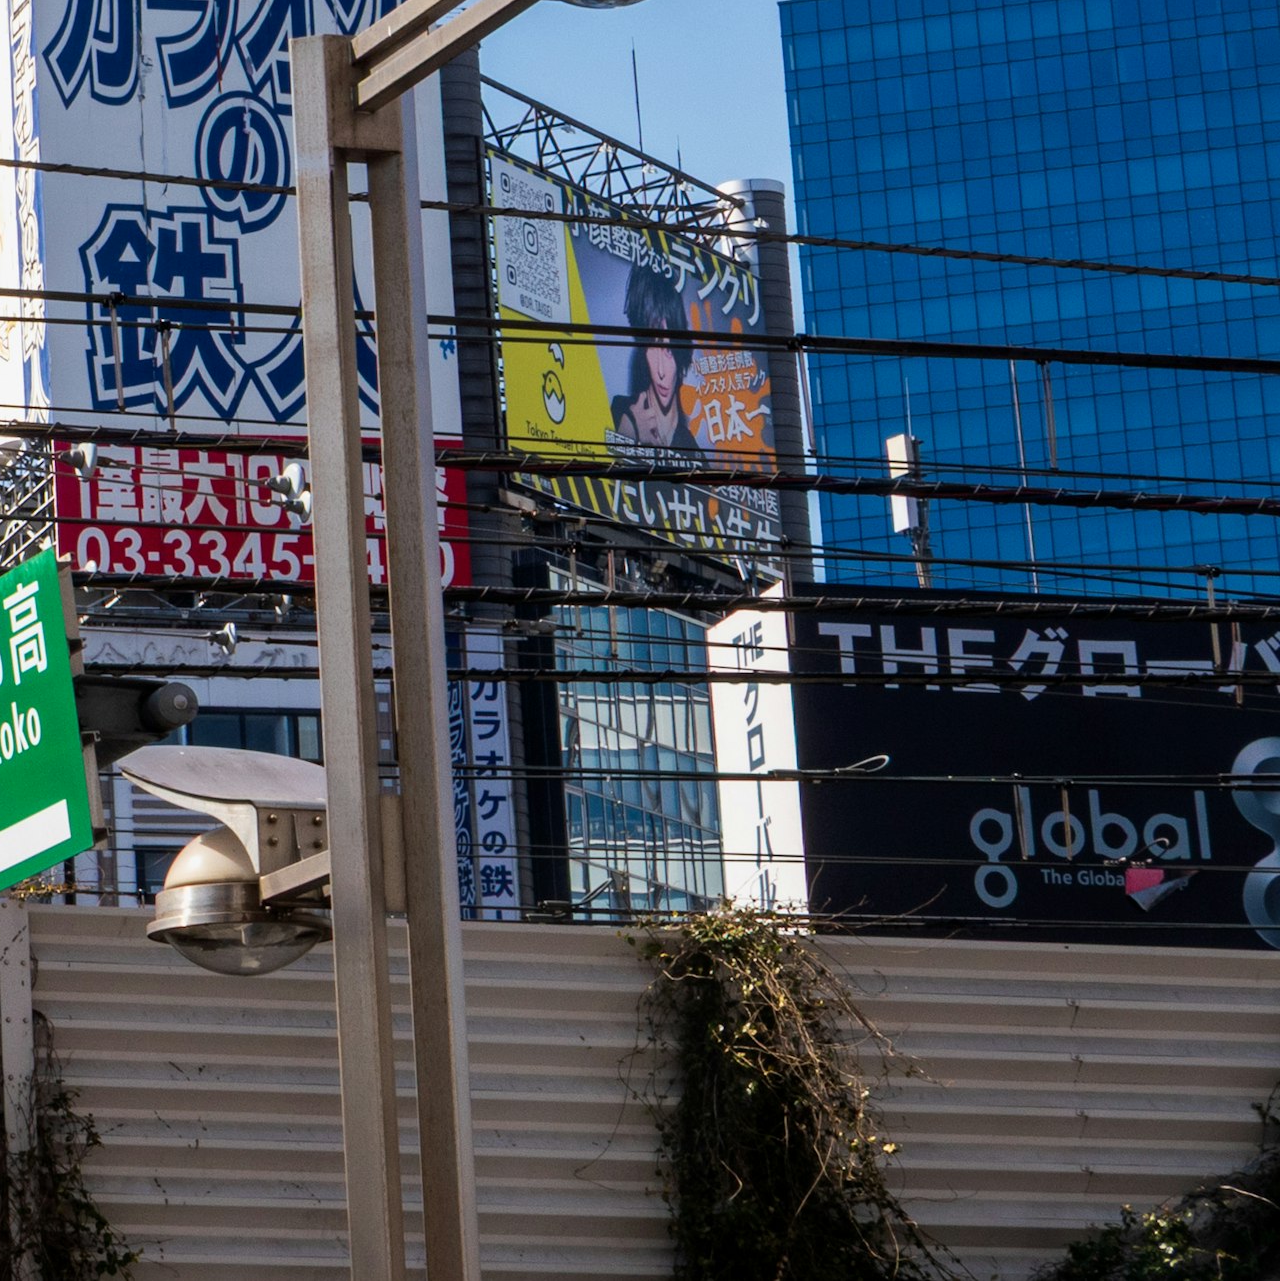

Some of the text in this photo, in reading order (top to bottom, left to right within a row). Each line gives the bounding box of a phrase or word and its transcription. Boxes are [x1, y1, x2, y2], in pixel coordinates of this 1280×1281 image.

[195, 91, 291, 233] の
[704, 394, 772, 444] 日本一
[969, 786, 1212, 909] global
[1041, 868, 1126, 887] The Globa
